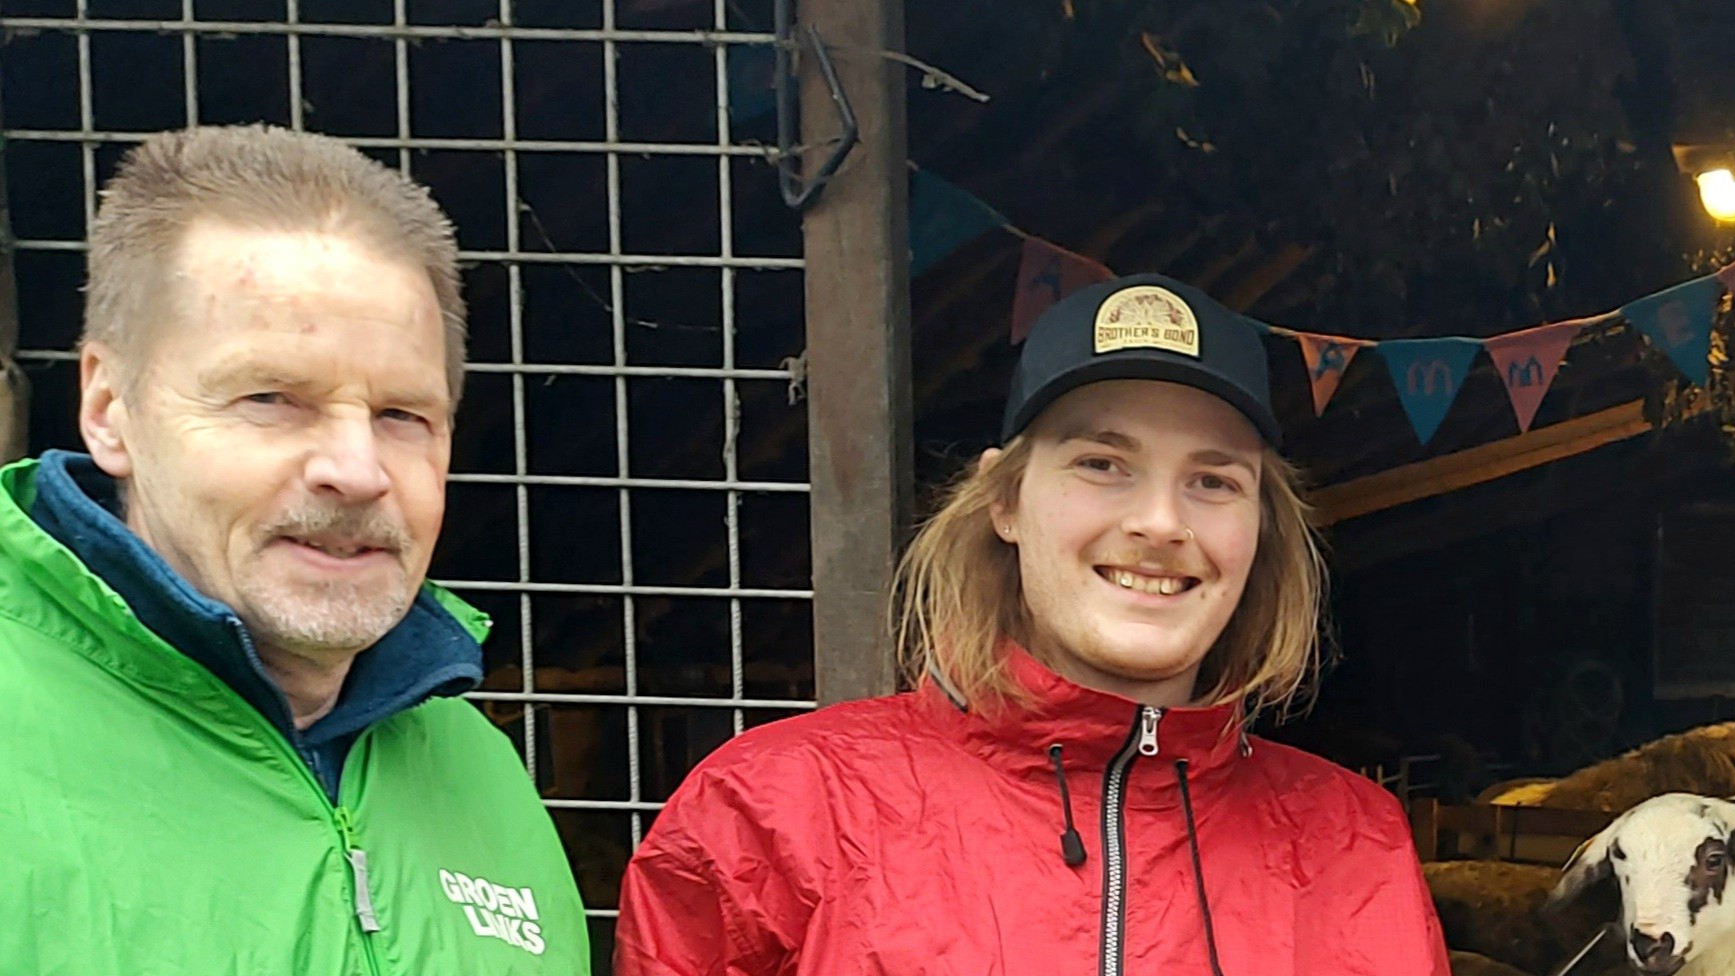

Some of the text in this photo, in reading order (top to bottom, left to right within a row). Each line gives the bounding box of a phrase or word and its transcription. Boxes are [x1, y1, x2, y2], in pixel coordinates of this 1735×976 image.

[1164, 329, 1195, 346] BOND
[439, 868, 540, 921] GROEN
[463, 904, 545, 955] LINKS
